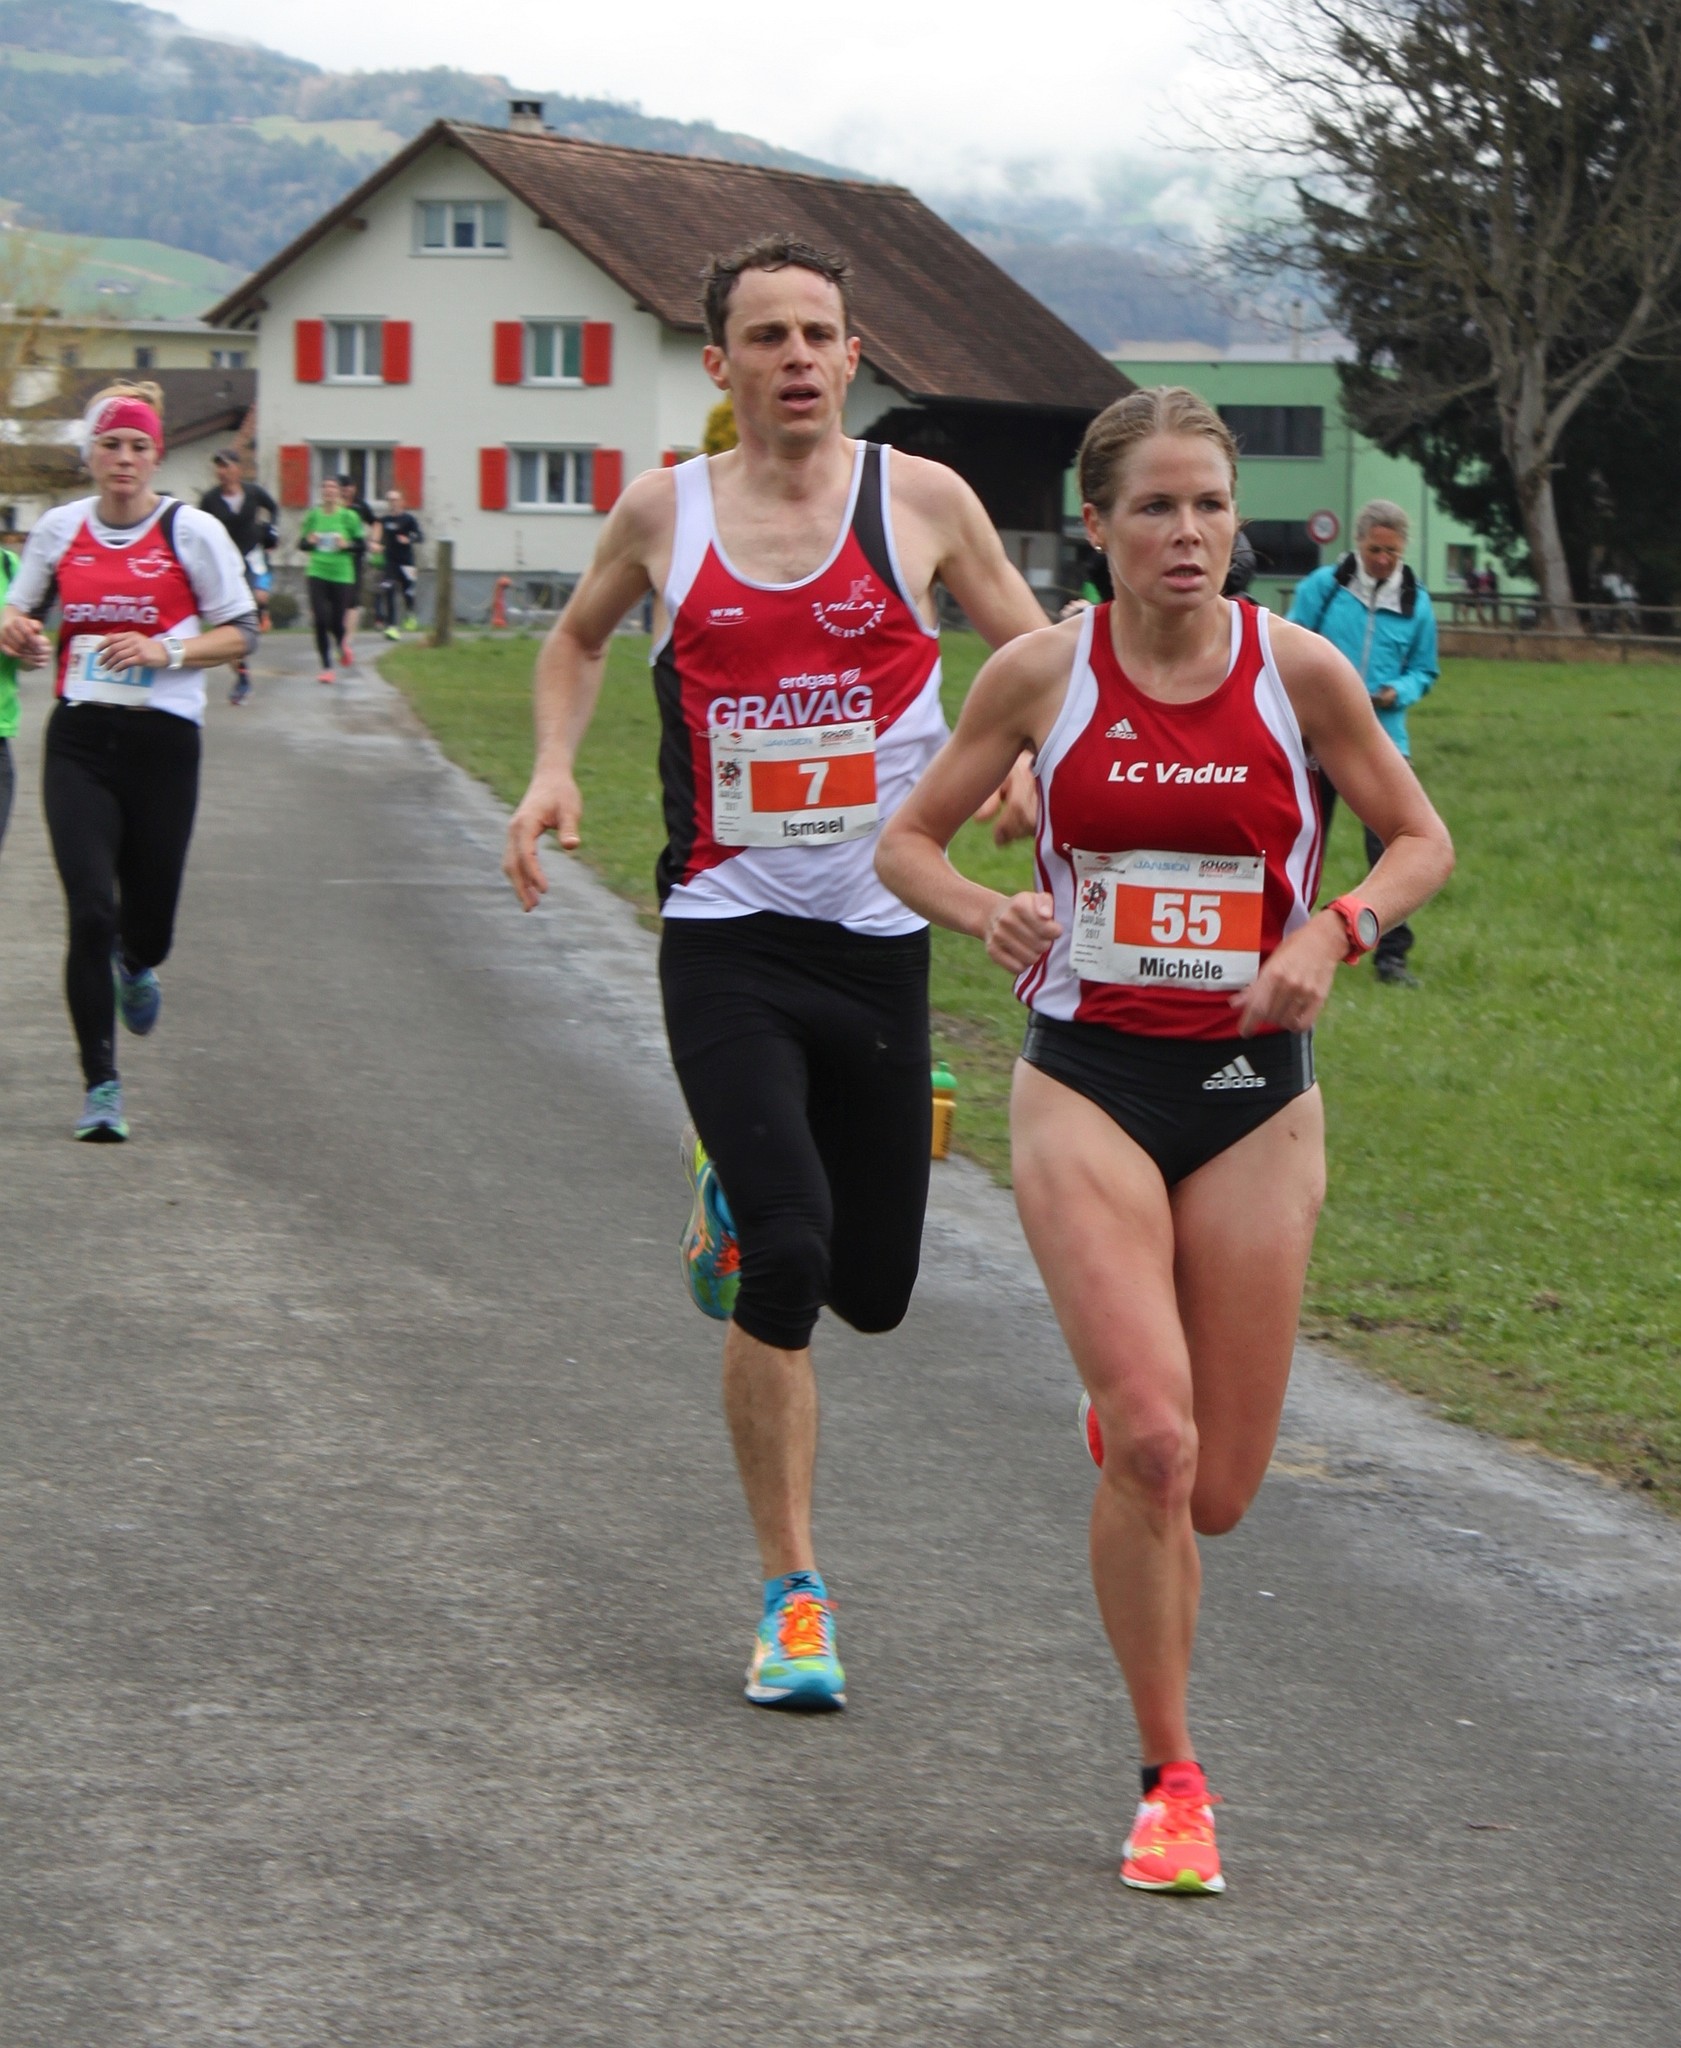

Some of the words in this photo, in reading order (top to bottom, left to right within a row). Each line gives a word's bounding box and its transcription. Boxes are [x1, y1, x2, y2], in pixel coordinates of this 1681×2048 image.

[64, 603, 159, 624] GRAVAG
[779, 673, 837, 689] erdgas
[707, 685, 873, 730] GRAVAG
[1105, 730, 1138, 740] adidas
[1107, 761, 1148, 783] LC
[1156, 762, 1248, 784] Vaduz
[798, 762, 829, 805] 7
[783, 816, 845, 837] Ismael
[1133, 860, 1191, 872] JANSEN
[1151, 892, 1222, 945] 55
[1139, 956, 1223, 979] Michèle
[1202, 1075, 1266, 1090] adidas
